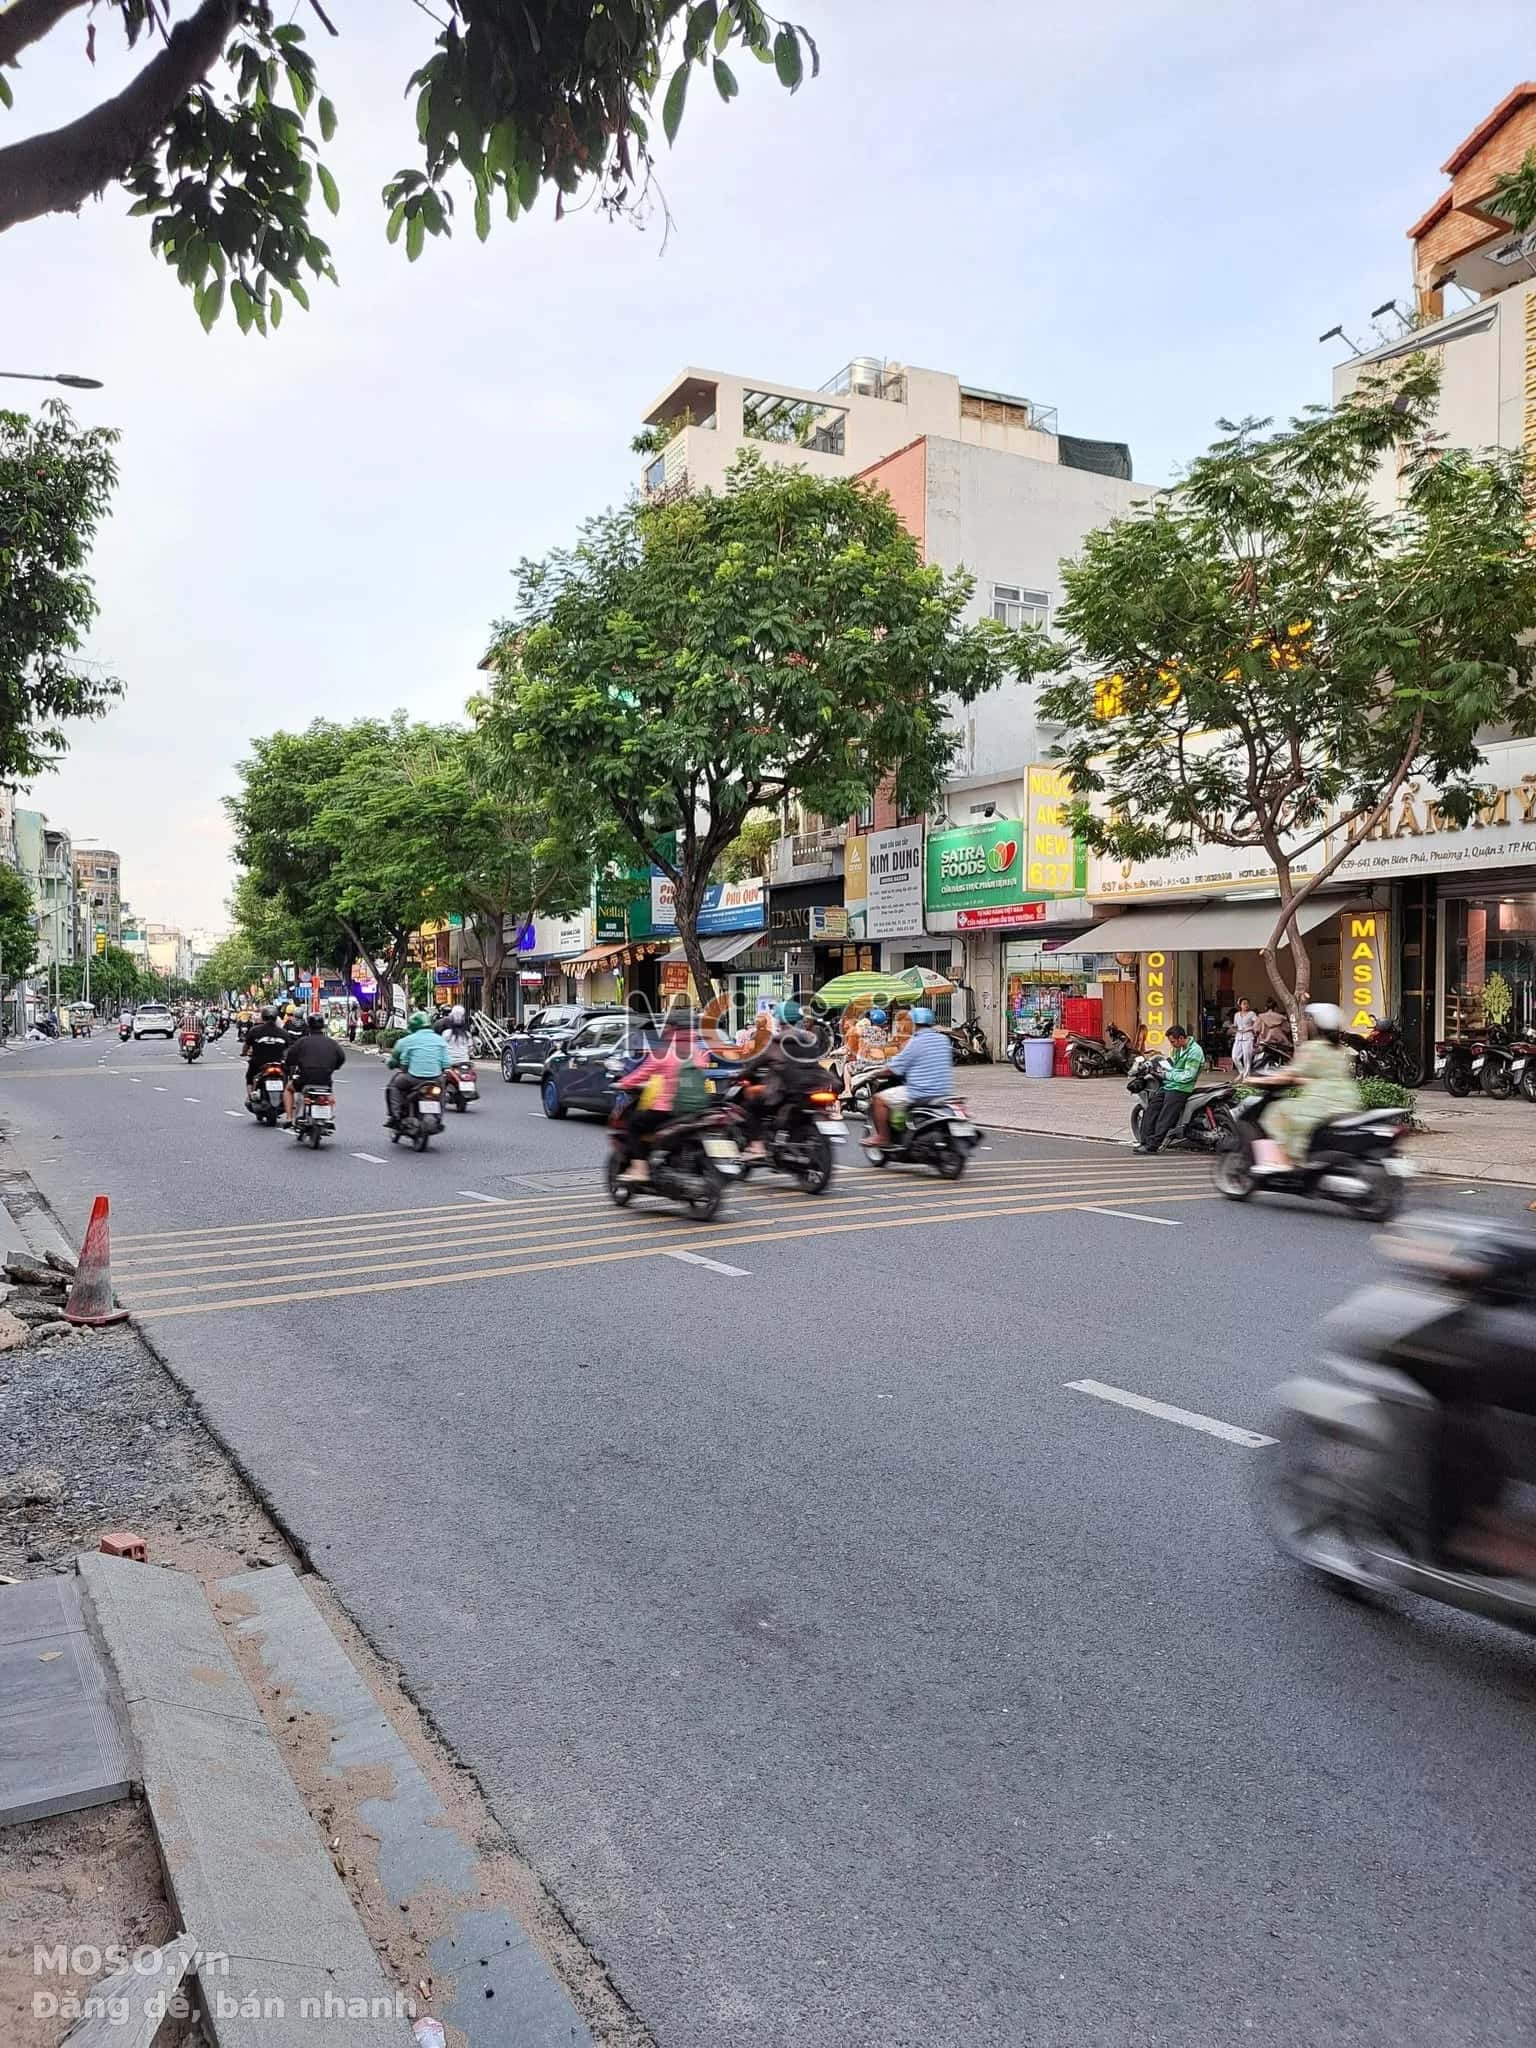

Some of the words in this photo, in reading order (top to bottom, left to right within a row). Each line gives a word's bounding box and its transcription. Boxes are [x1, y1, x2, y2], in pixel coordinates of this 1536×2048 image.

[941, 846, 985, 865] SATRA
[1034, 833, 1068, 857] NEW
[1340, 857, 1371, 870] 639-641
[1507, 840, 1536, 855] TP.HC
[870, 852, 889, 874] KIM
[892, 848, 919, 871] DUNG
[940, 860, 986, 879] FOODS
[1030, 862, 1071, 887] 637
[660, 884, 675, 894] PH
[598, 905, 624, 918] Nella
[1351, 919, 1376, 1040] MASSA
